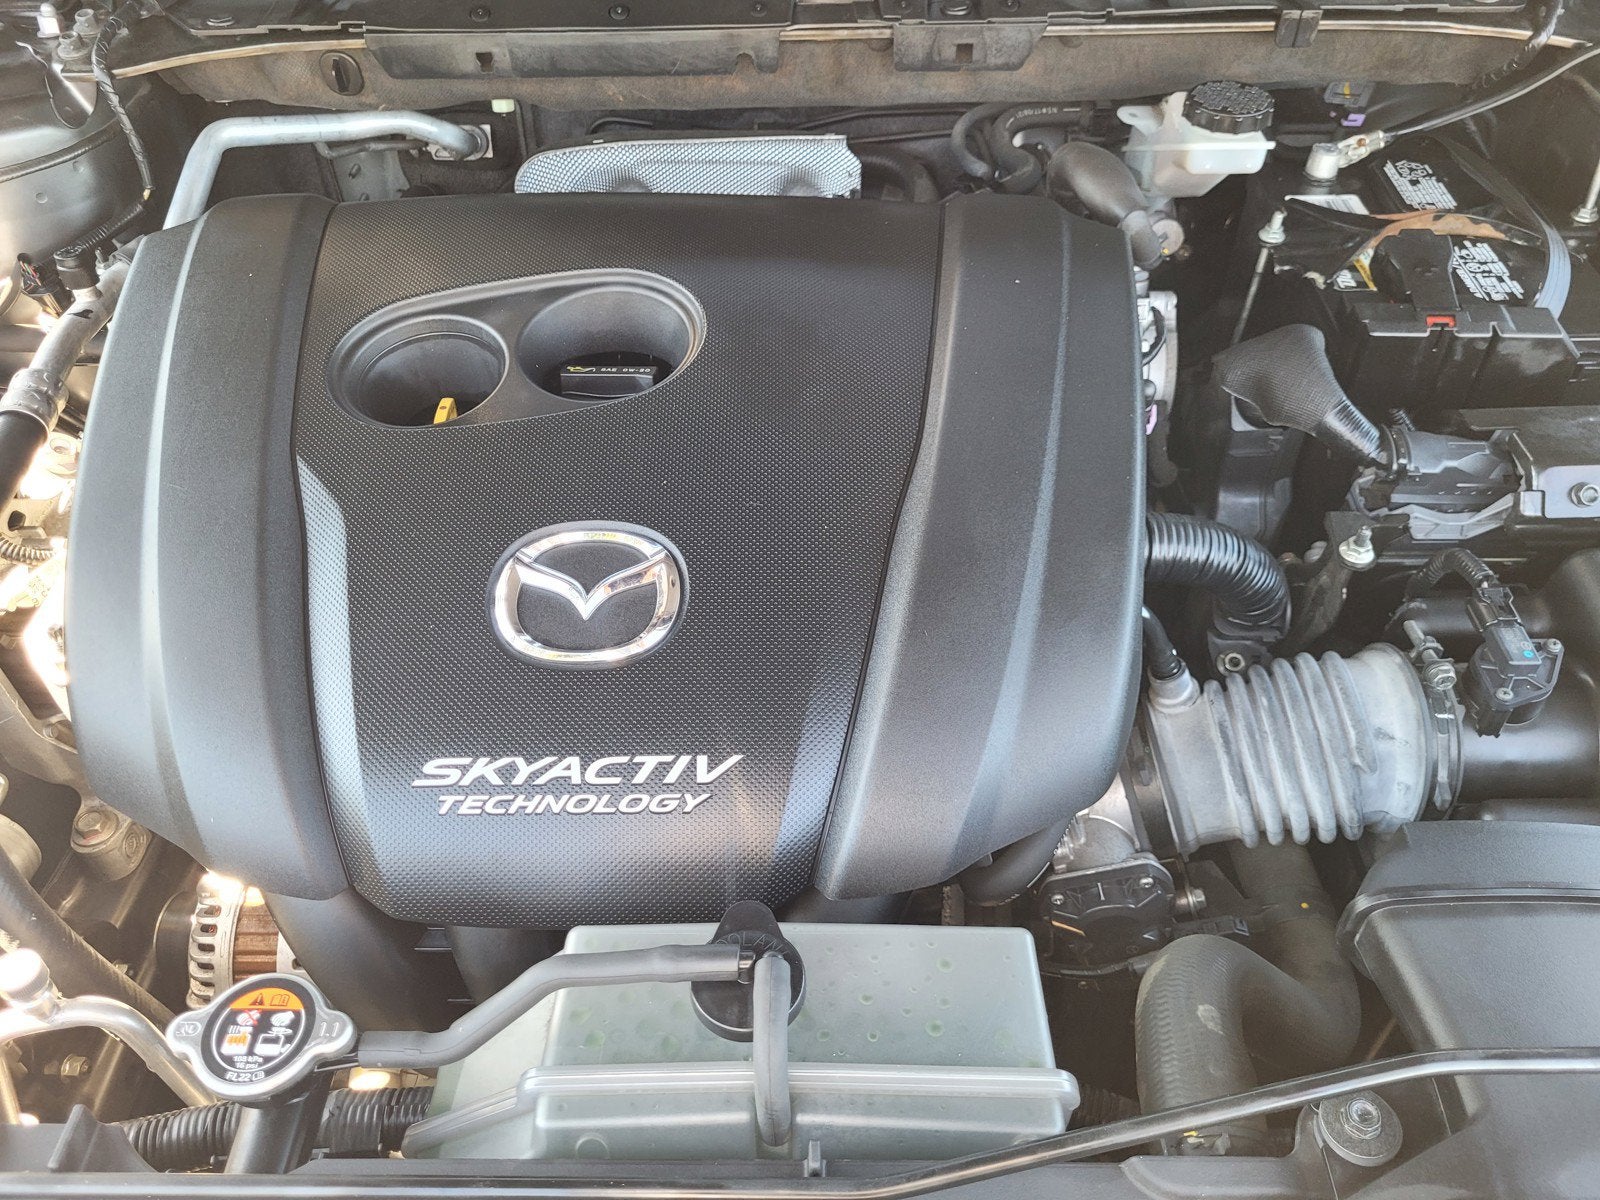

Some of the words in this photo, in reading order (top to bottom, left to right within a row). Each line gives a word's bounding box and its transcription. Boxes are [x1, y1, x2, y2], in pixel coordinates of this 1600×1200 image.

[411, 754, 745, 787] SKYACTIV
[437, 793, 712, 815] TECHNOLOGY
[226, 1071, 251, 1081] FL22
